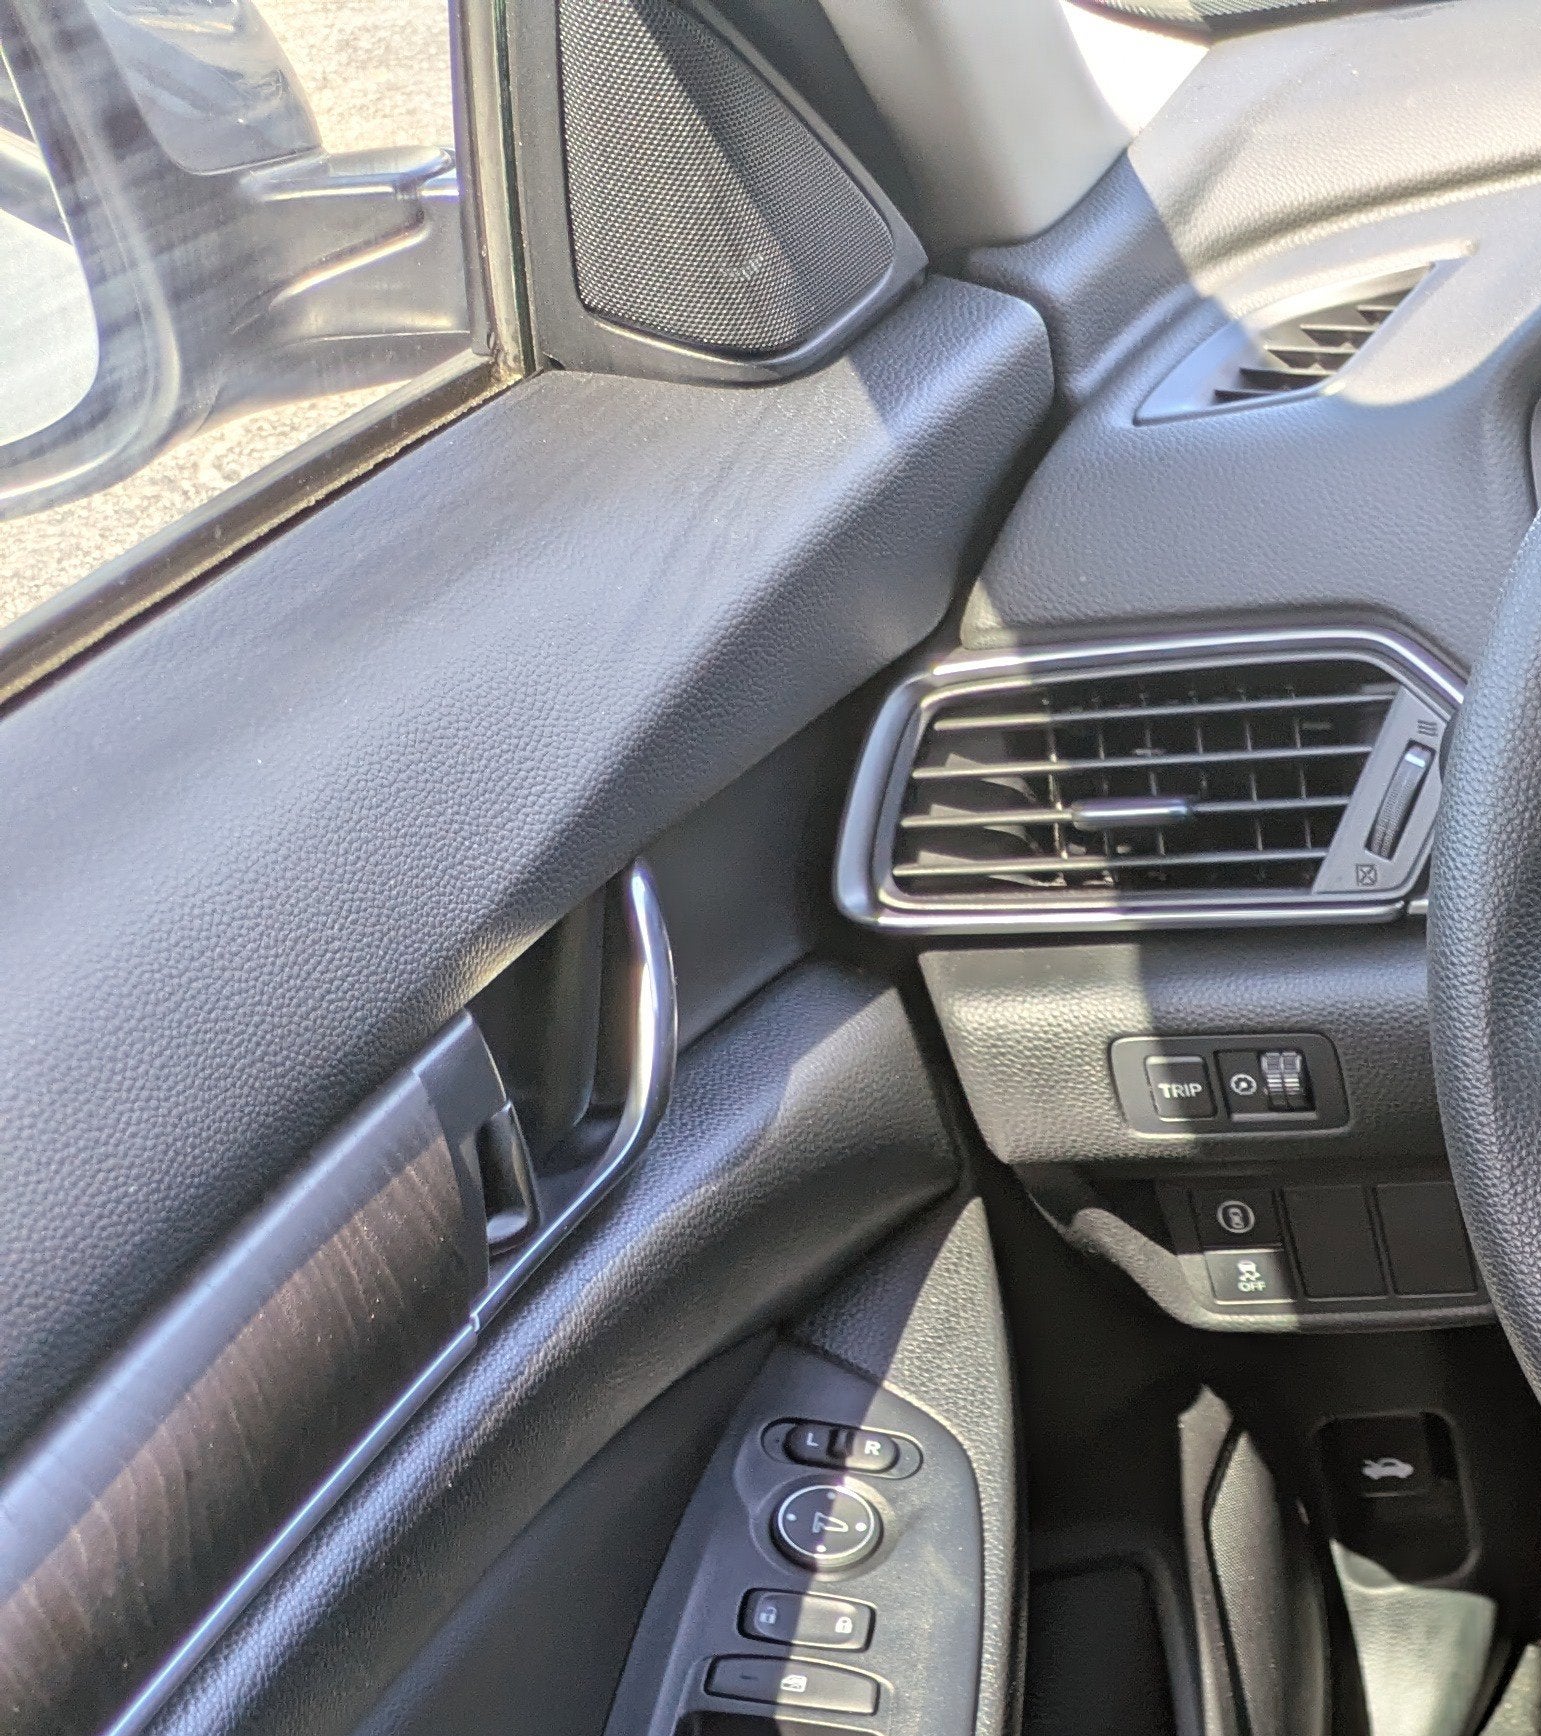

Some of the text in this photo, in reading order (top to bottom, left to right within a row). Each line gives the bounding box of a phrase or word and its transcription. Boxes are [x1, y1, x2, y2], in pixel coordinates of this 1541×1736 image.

[1158, 1082, 1201, 1097] TRIP
[1237, 1279, 1265, 1291] OFF
[806, 1433, 817, 1446] L
[864, 1440, 879, 1454] R
